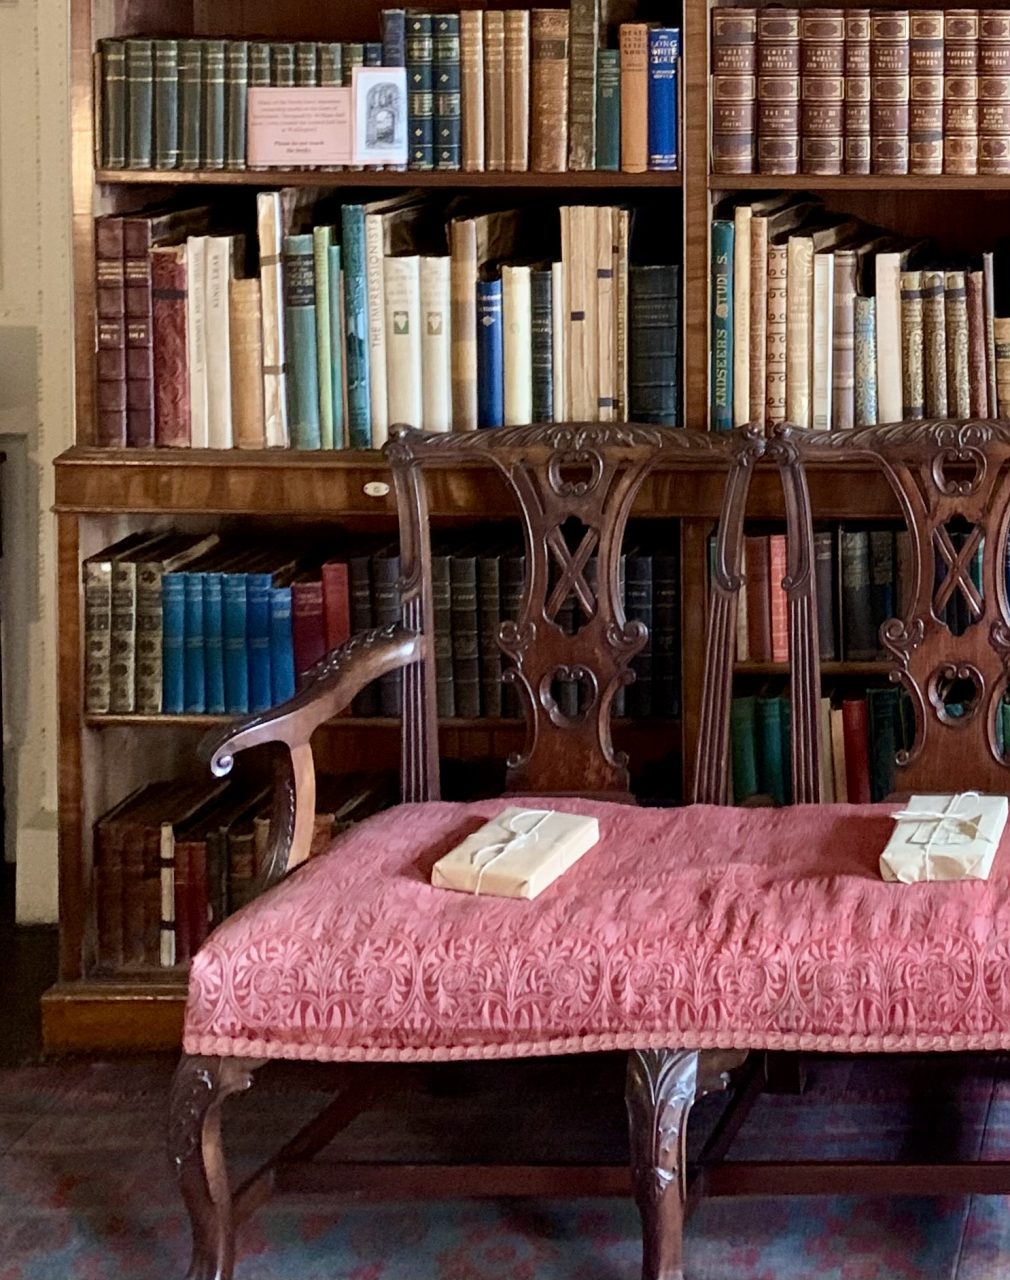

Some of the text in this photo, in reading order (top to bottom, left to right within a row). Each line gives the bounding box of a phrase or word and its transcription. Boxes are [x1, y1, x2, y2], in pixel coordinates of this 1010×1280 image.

[652, 40, 677, 48] LONG
[367, 219, 382, 348] THE IMPRESSIONISTS
[715, 328, 728, 407] ANDSEERS
